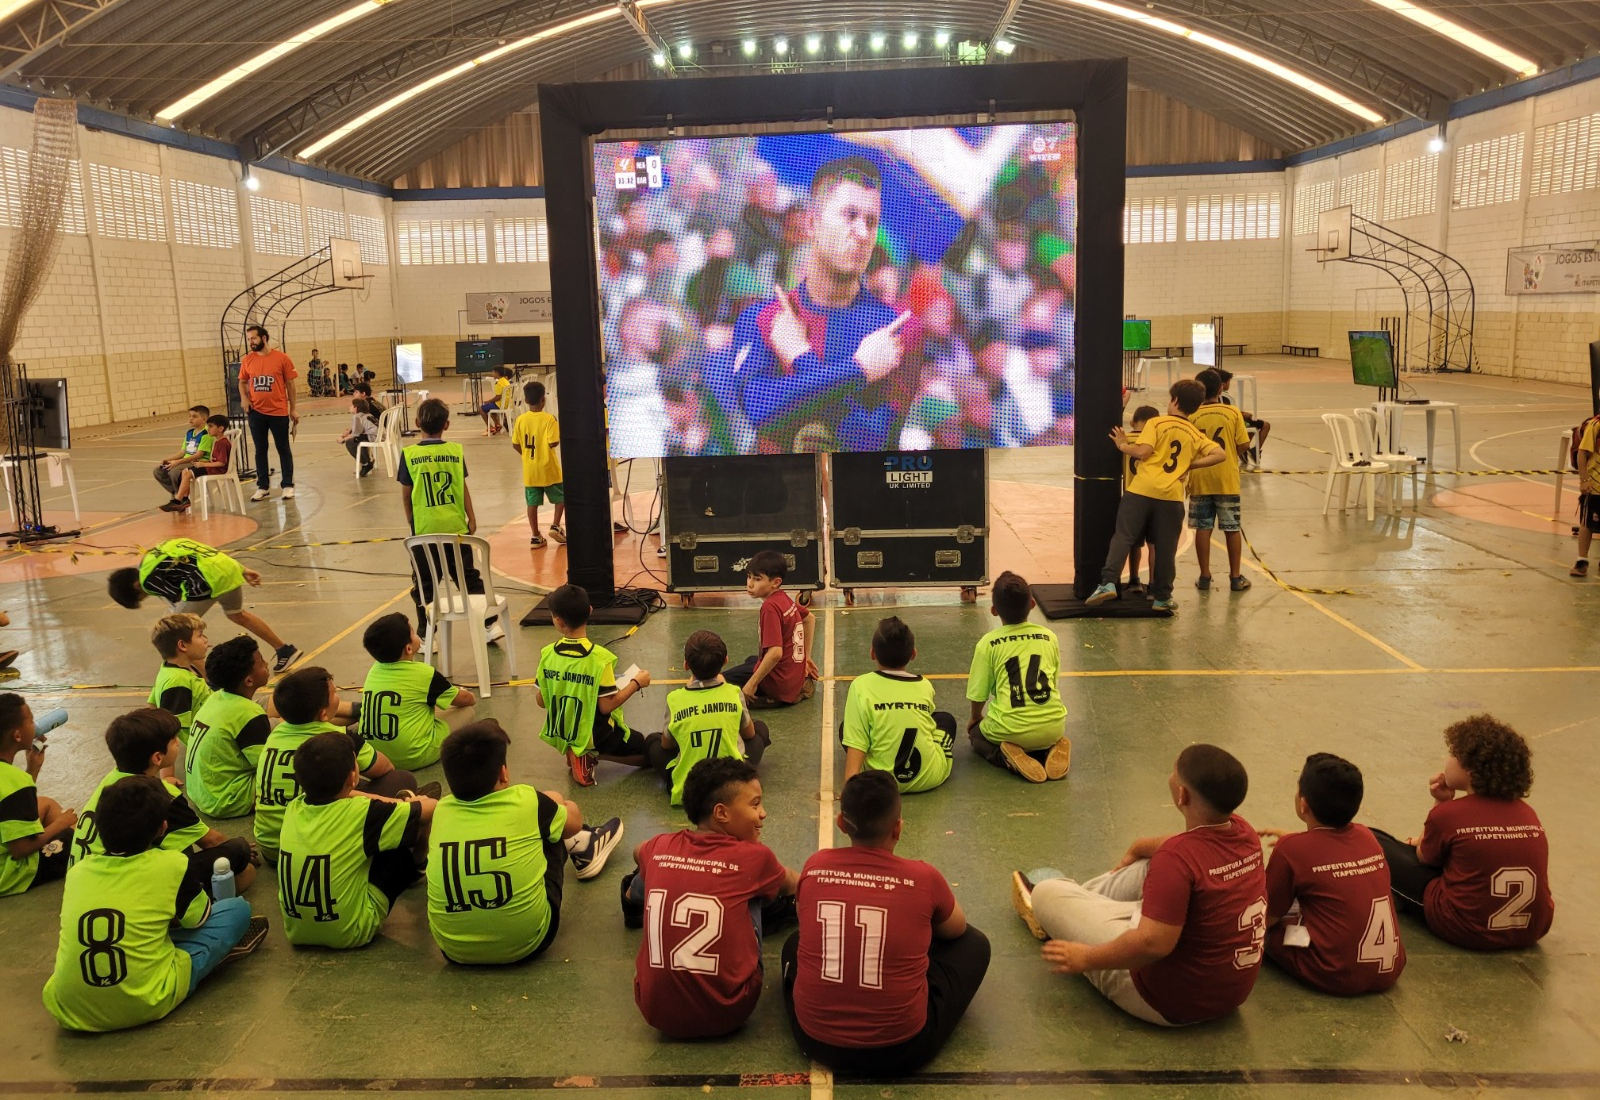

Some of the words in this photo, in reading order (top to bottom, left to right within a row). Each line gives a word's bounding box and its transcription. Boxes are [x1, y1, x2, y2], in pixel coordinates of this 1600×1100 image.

[1556, 253, 1582, 265] JOGOS
[520, 297, 546, 305] JOGOS
[525, 434, 536, 458] 4
[1163, 440, 1181, 473] 3
[411, 455, 432, 465] EQUIPE
[434, 455, 460, 463] JANDYRA
[884, 456, 933, 470] PRO
[420, 471, 455, 507] 12
[891, 473, 929, 481] LIGHT
[990, 633, 1050, 647] MYRTHES
[562, 671, 595, 686] JANDYRA
[1004, 654, 1051, 708] 16
[362, 691, 402, 741] 16
[545, 695, 583, 742] 10
[673, 705, 699, 723] EQUIPE
[702, 702, 738, 714] JANDYRA
[187, 720, 210, 774] 7
[690, 728, 722, 758] 7
[894, 728, 922, 783] 6
[260, 748, 301, 806] 13
[1456, 826, 1505, 834] PREFEITURA
[439, 836, 513, 913] 15
[658, 862, 705, 872] ITAPETININGA
[687, 857, 727, 868] MUNICIPAL
[729, 863, 739, 871] DE
[1209, 859, 1243, 876] PREFEITURA
[1223, 864, 1256, 881] ITAPETININGA
[1312, 861, 1358, 873] PREFEITURA
[1333, 864, 1377, 878] ITAPETININGA
[280, 849, 339, 922] 14
[817, 877, 876, 888] ITAPETININGA
[853, 871, 901, 884] MUNICIPAL
[903, 879, 915, 887] DE
[1487, 866, 1537, 930] 2
[646, 888, 724, 976] 12
[1232, 895, 1268, 970] 3
[1357, 895, 1399, 973] 4
[78, 908, 128, 987] 8
[817, 900, 888, 990] 11
